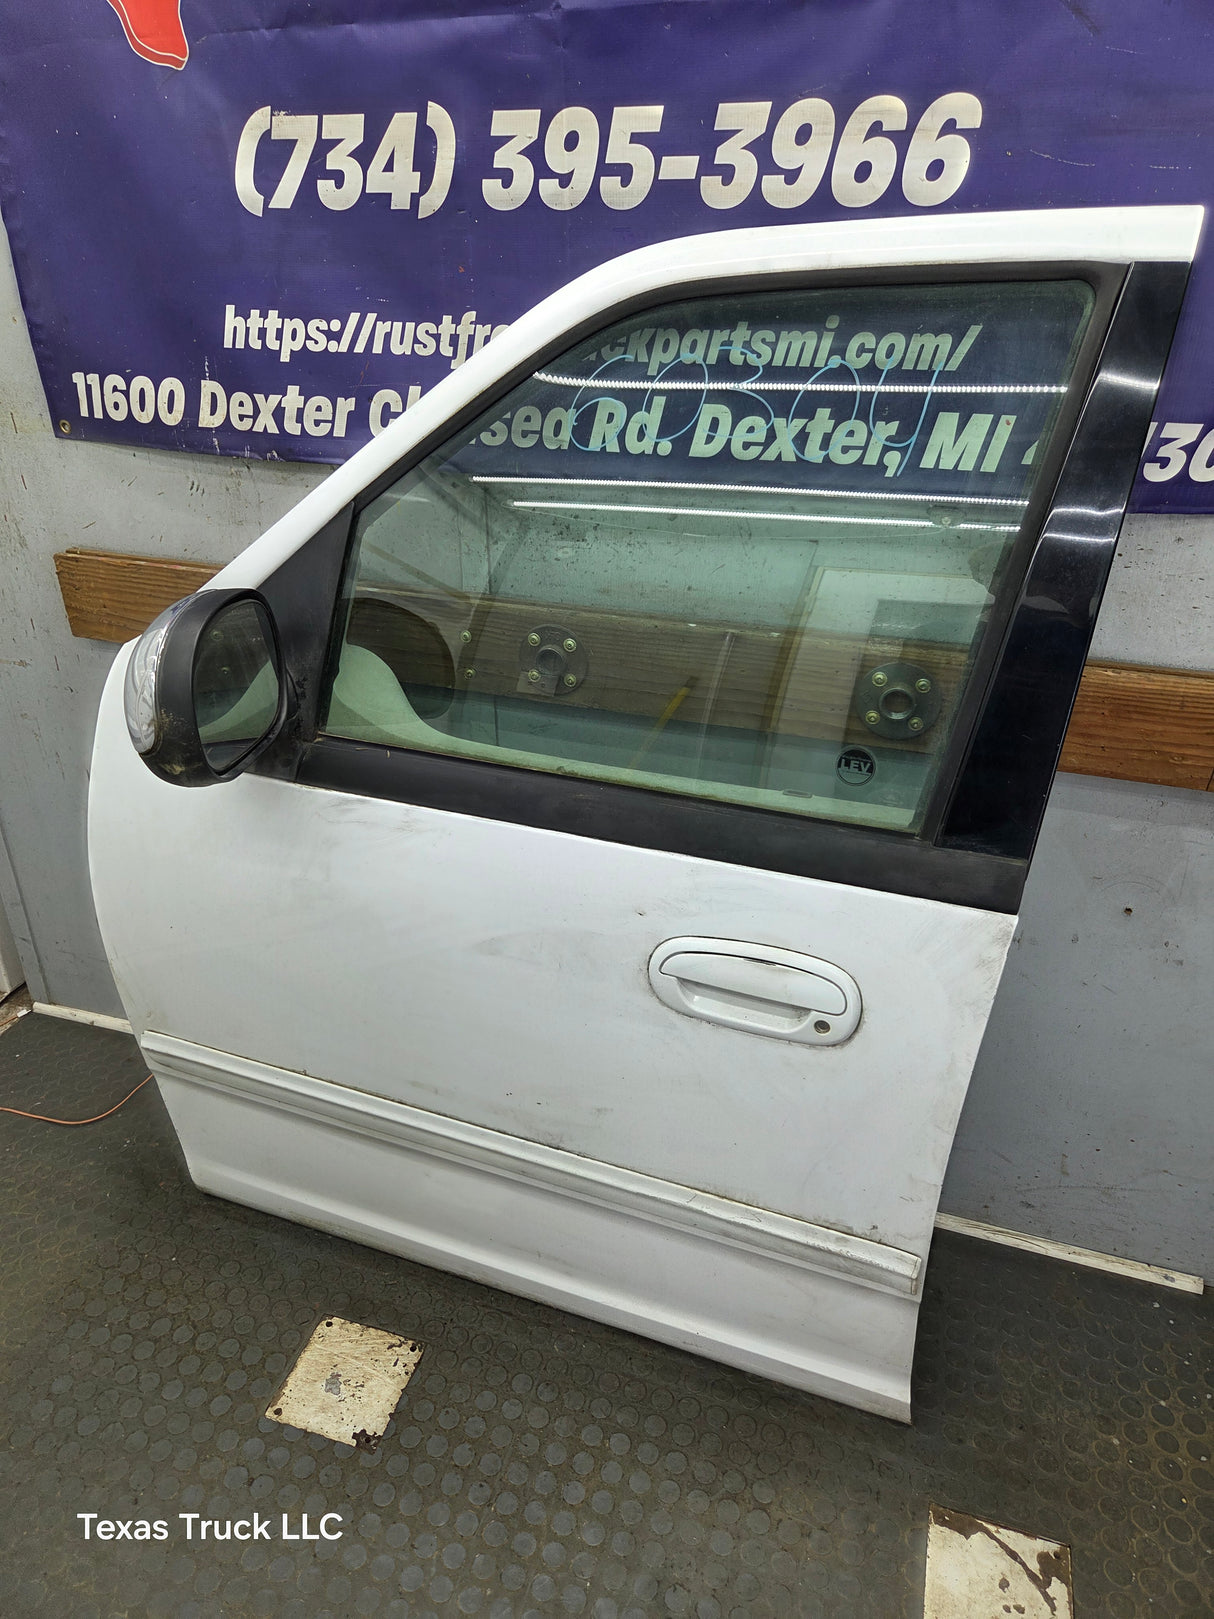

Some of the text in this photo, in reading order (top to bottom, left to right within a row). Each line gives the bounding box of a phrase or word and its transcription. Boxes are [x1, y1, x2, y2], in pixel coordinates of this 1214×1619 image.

[234, 92, 983, 219] (734) 395-3966
[72, 371, 186, 425] 11600
[199, 380, 356, 437] Dexter
[588, 396, 674, 457] Rd.
[688, 402, 901, 479] Dexter,
[919, 411, 1016, 474] MI
[839, 758, 871, 774] LEV
